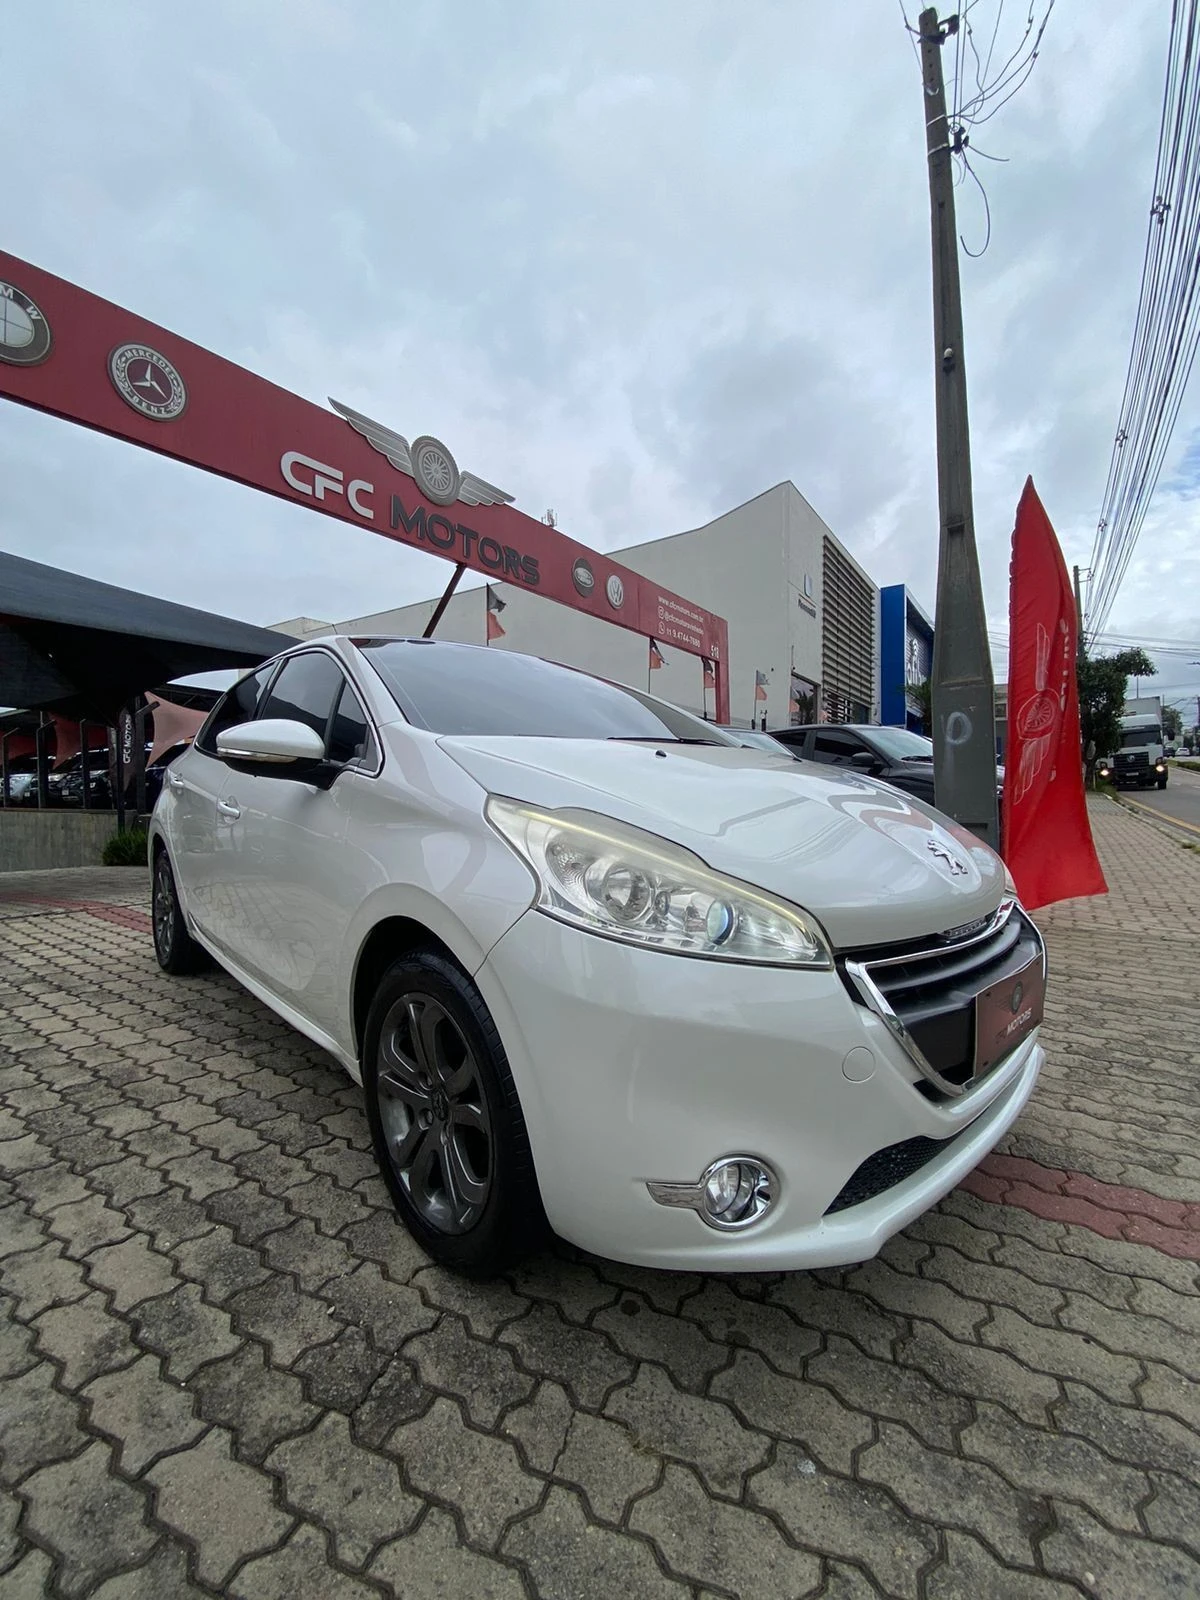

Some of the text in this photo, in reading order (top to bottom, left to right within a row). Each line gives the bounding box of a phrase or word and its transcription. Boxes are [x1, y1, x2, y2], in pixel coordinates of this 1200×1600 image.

[0, 284, 42, 320] MW
[124, 349, 176, 380] MERCEDES
[132, 396, 168, 414] BENZ
[280, 451, 540, 585] CFC MOTORS
